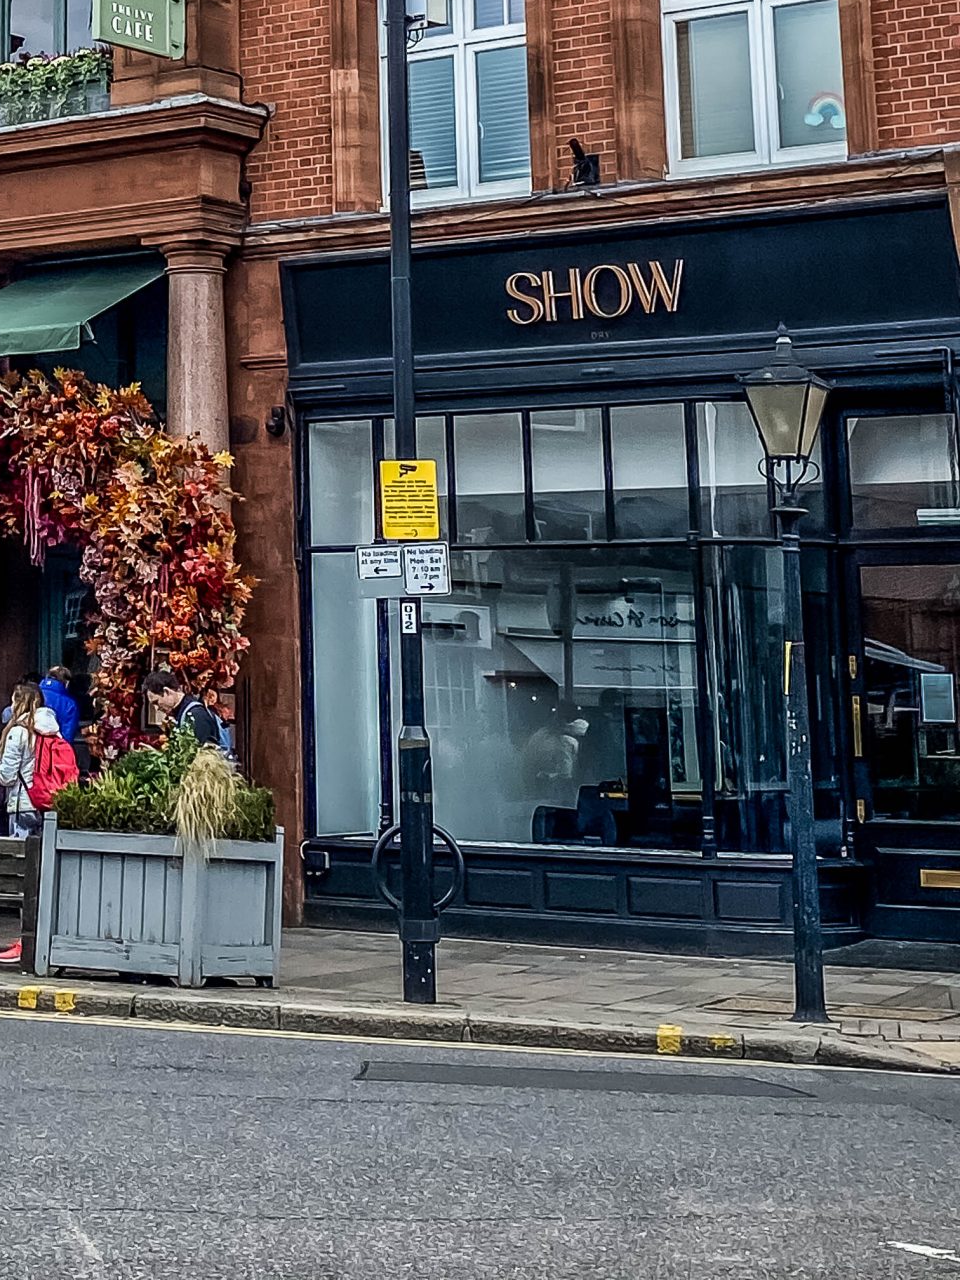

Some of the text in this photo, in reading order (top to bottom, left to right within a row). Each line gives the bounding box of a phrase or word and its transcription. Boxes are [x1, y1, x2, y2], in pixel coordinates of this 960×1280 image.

[134, 9, 153, 22] IVY
[505, 258, 684, 325] SHOW
[373, 550, 398, 558] loading
[418, 548, 444, 556] loading
